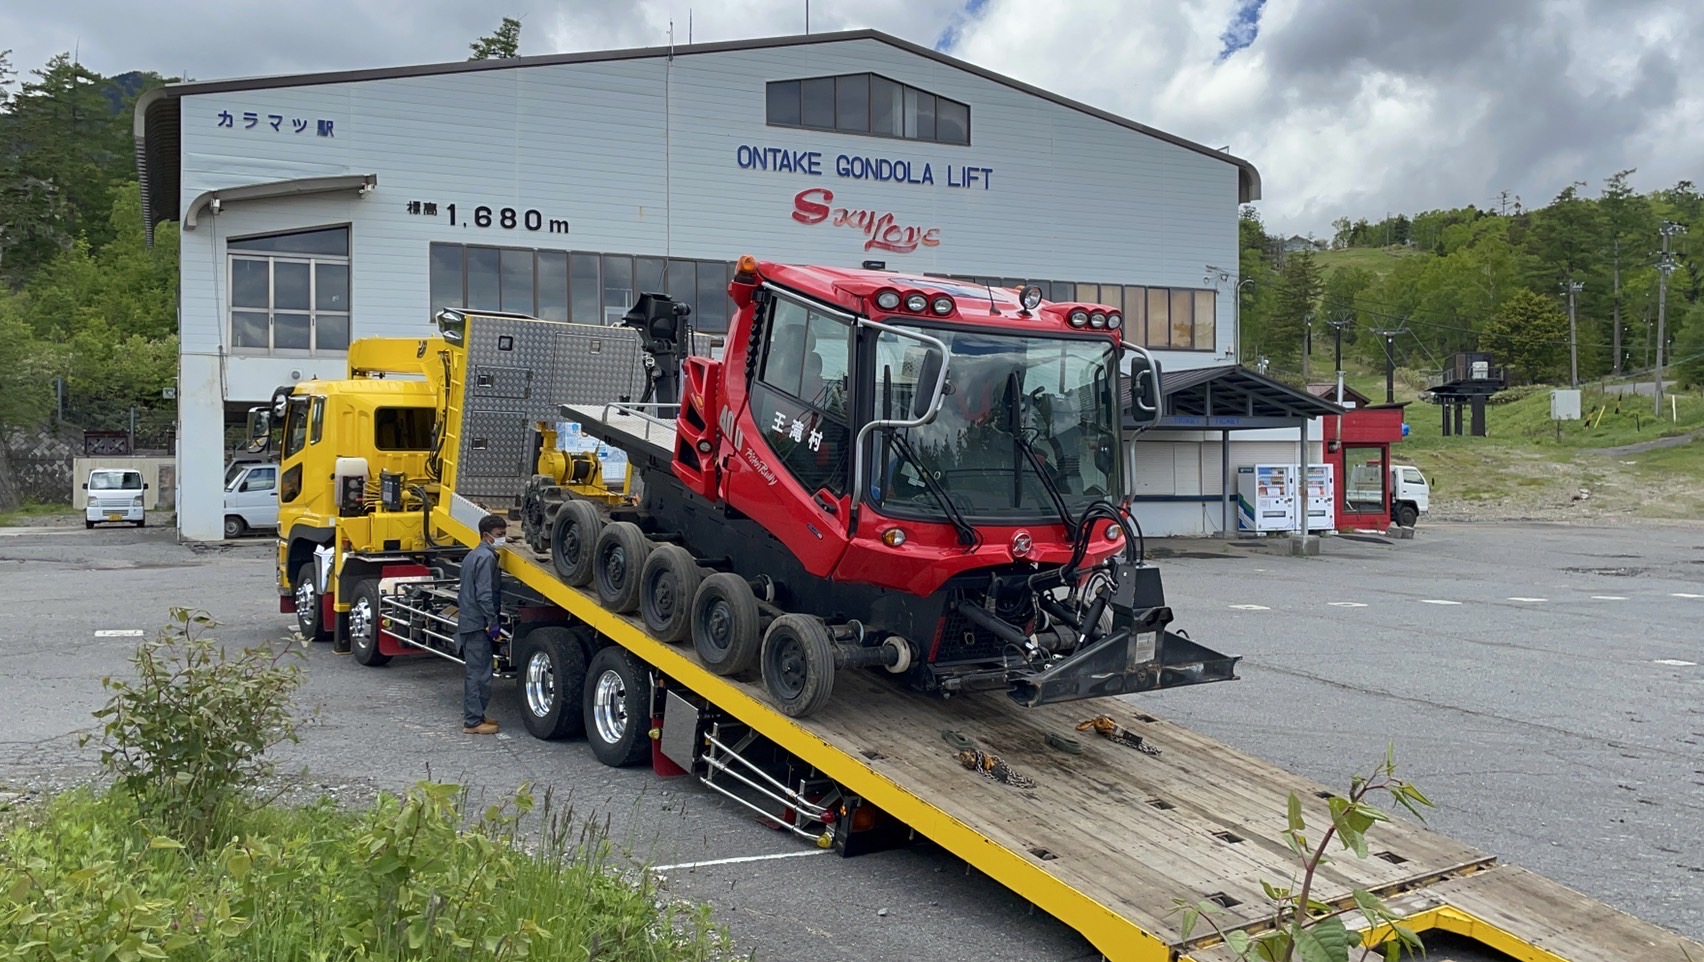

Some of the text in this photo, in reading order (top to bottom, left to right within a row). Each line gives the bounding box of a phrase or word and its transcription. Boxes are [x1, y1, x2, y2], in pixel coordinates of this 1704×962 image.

[217, 110, 335, 138] カラマツ駅
[737, 145, 993, 189] ONTAKE GONDOLA LIFT
[407, 201, 438, 216] 標高
[771, 410, 823, 452] 王滝村
